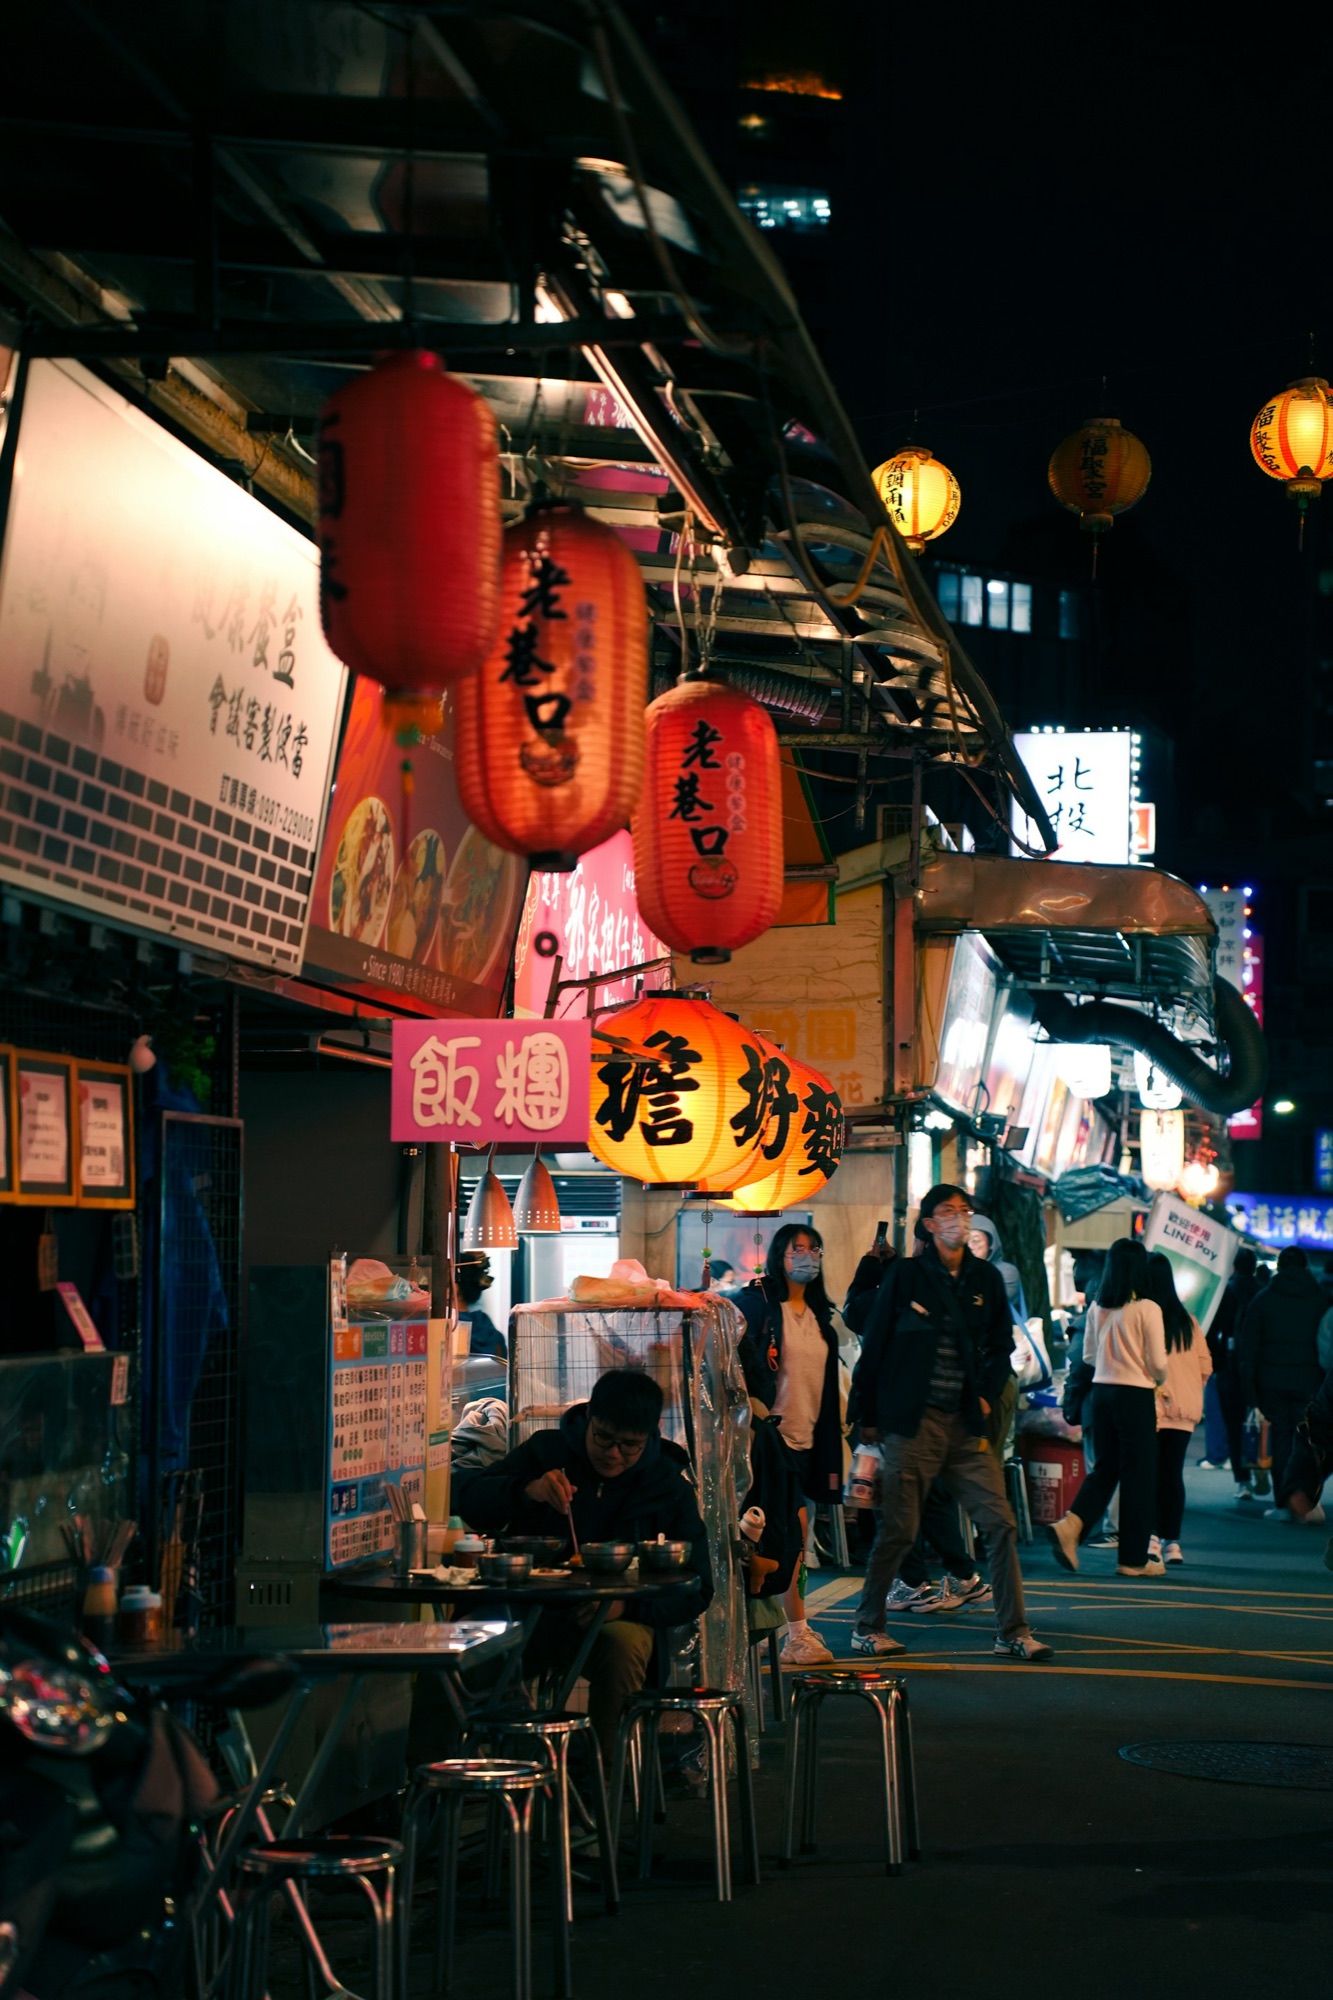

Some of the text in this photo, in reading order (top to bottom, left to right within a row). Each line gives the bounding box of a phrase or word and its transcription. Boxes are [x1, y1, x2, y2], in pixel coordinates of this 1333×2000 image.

[1081, 437, 1108, 499] 福聚宮
[499, 557, 574, 731] 老巷口
[208, 672, 310, 780] 會議客製便當
[668, 719, 732, 857] 老巷口
[1046, 756, 1096, 837] 北投
[1163, 1224, 1219, 1262] LINE Pay
[1167, 1210, 1212, 1242] 歡迎使用
